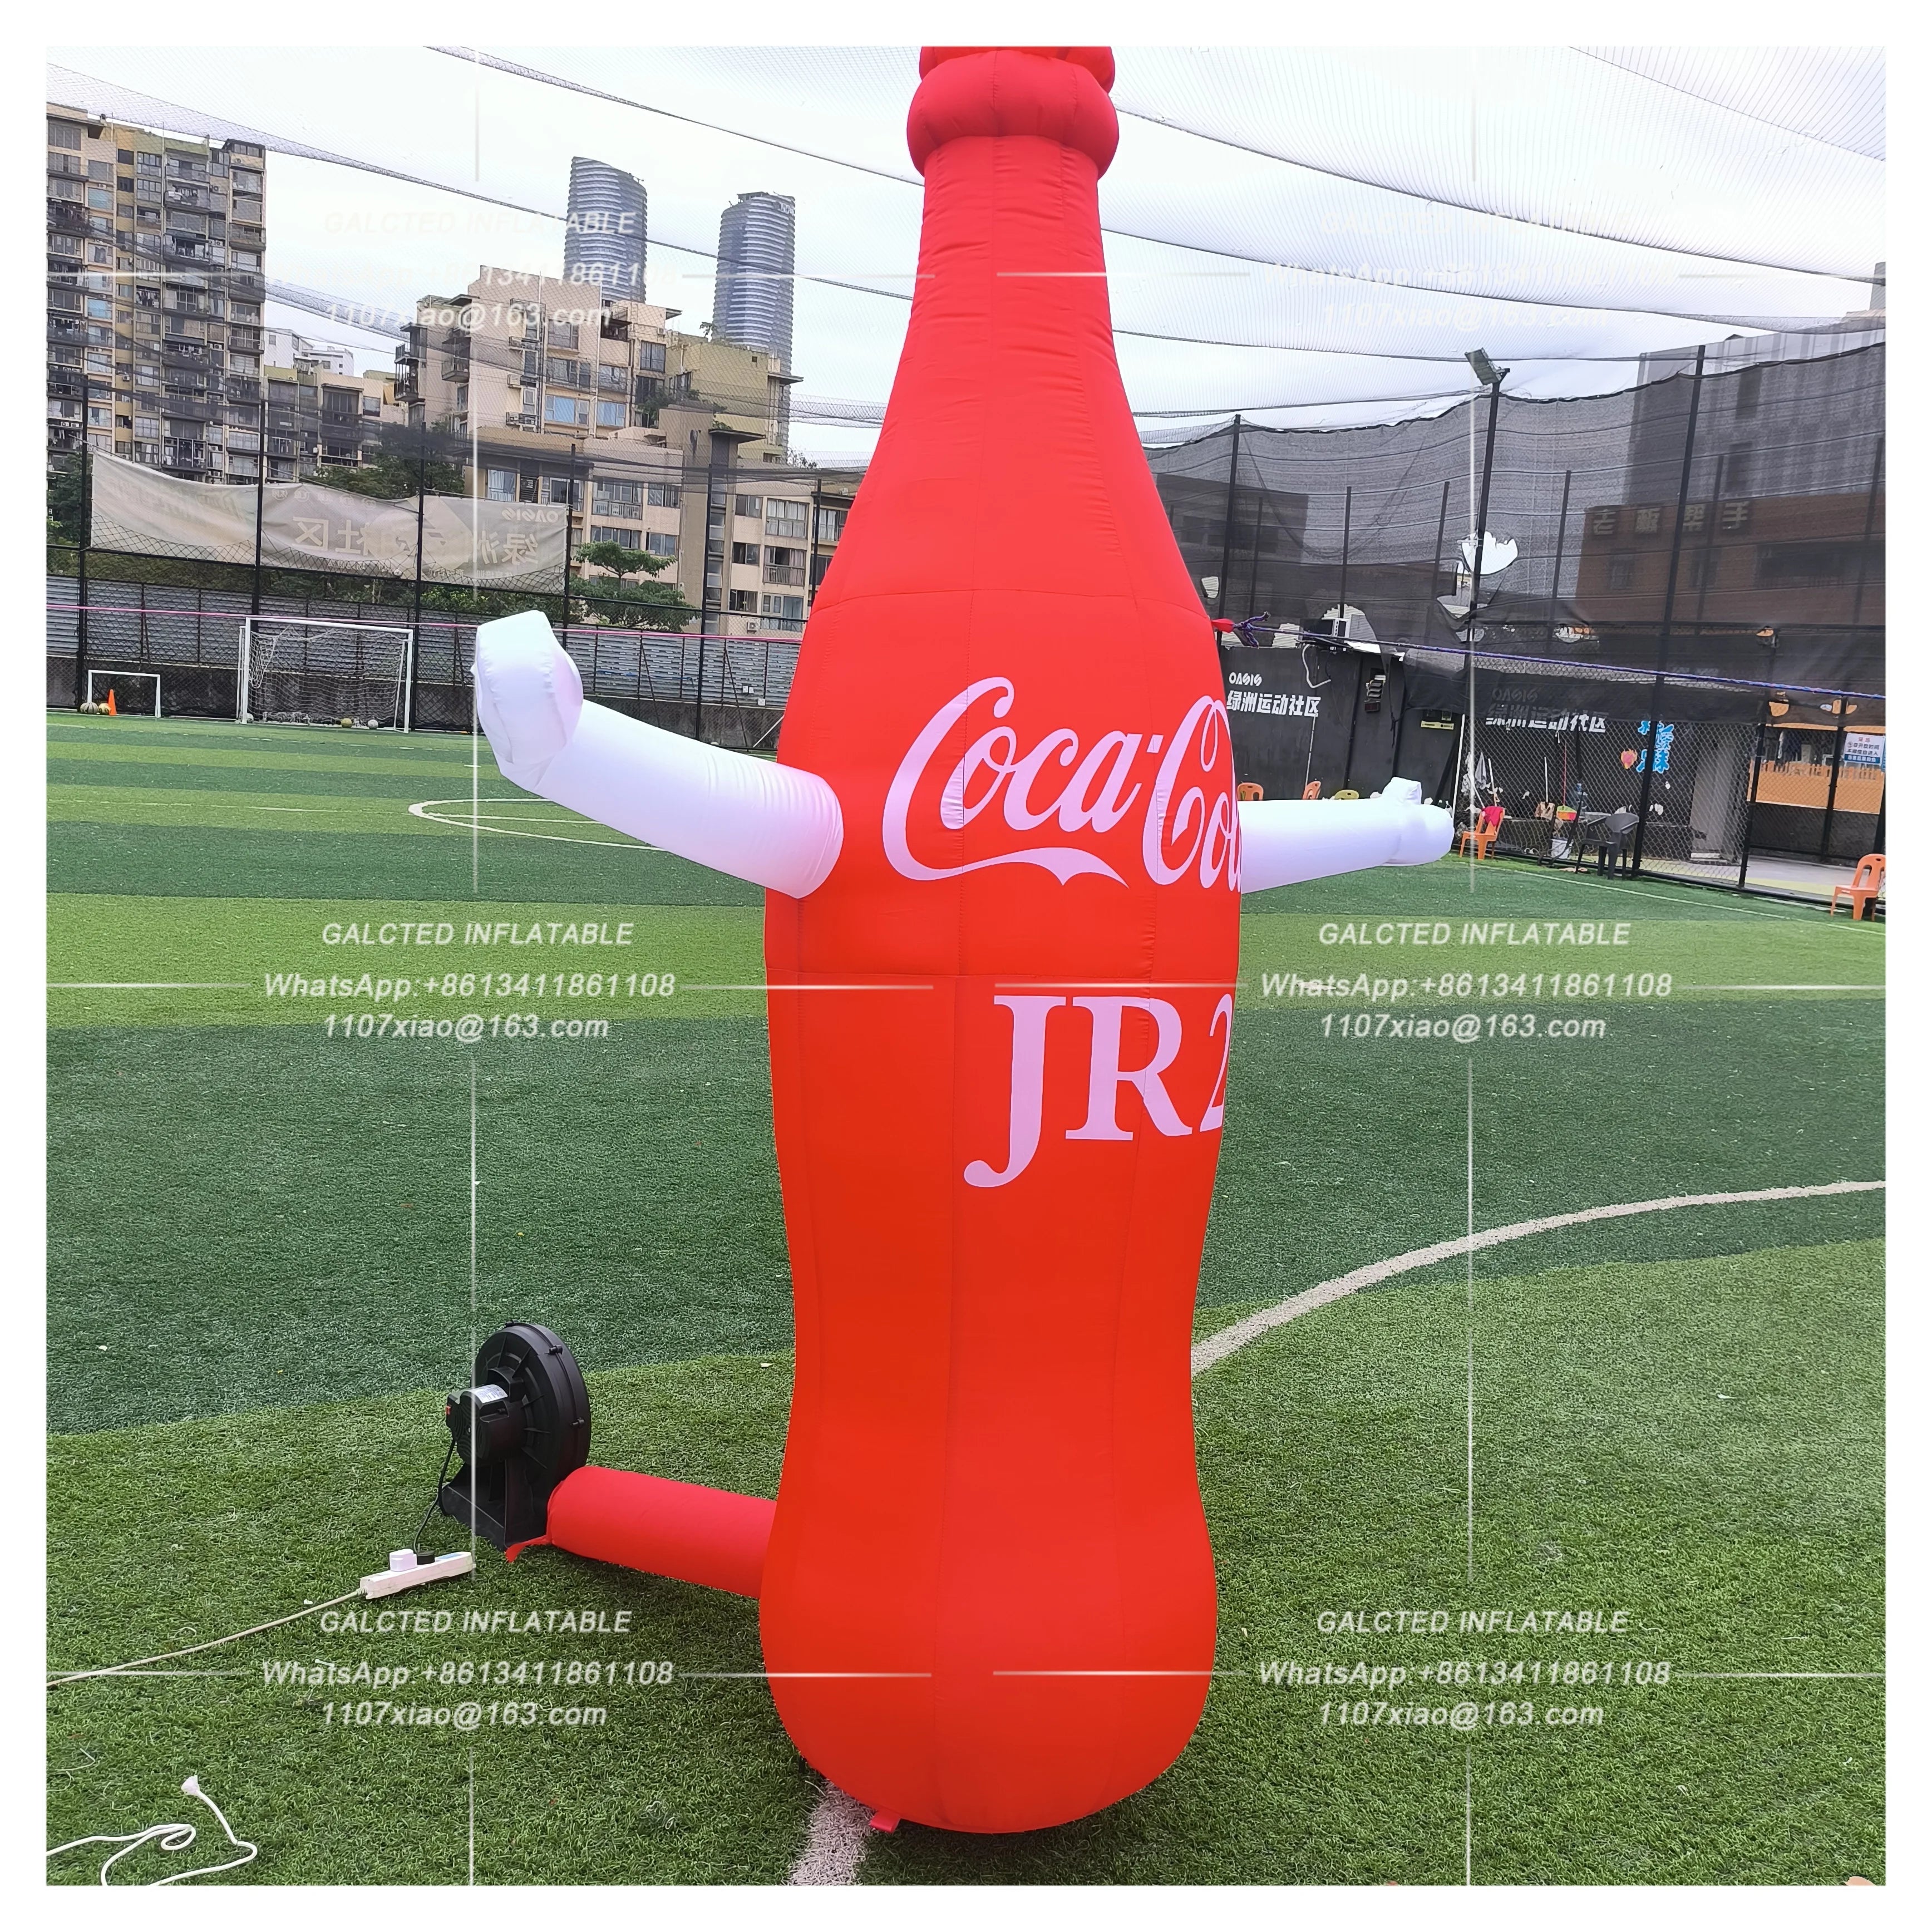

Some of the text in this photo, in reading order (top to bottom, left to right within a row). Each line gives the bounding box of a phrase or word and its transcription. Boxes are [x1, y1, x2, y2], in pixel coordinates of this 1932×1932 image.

[1229, 672, 1262, 687] OASIS
[1226, 690, 1321, 717] 绿洲运动社区
